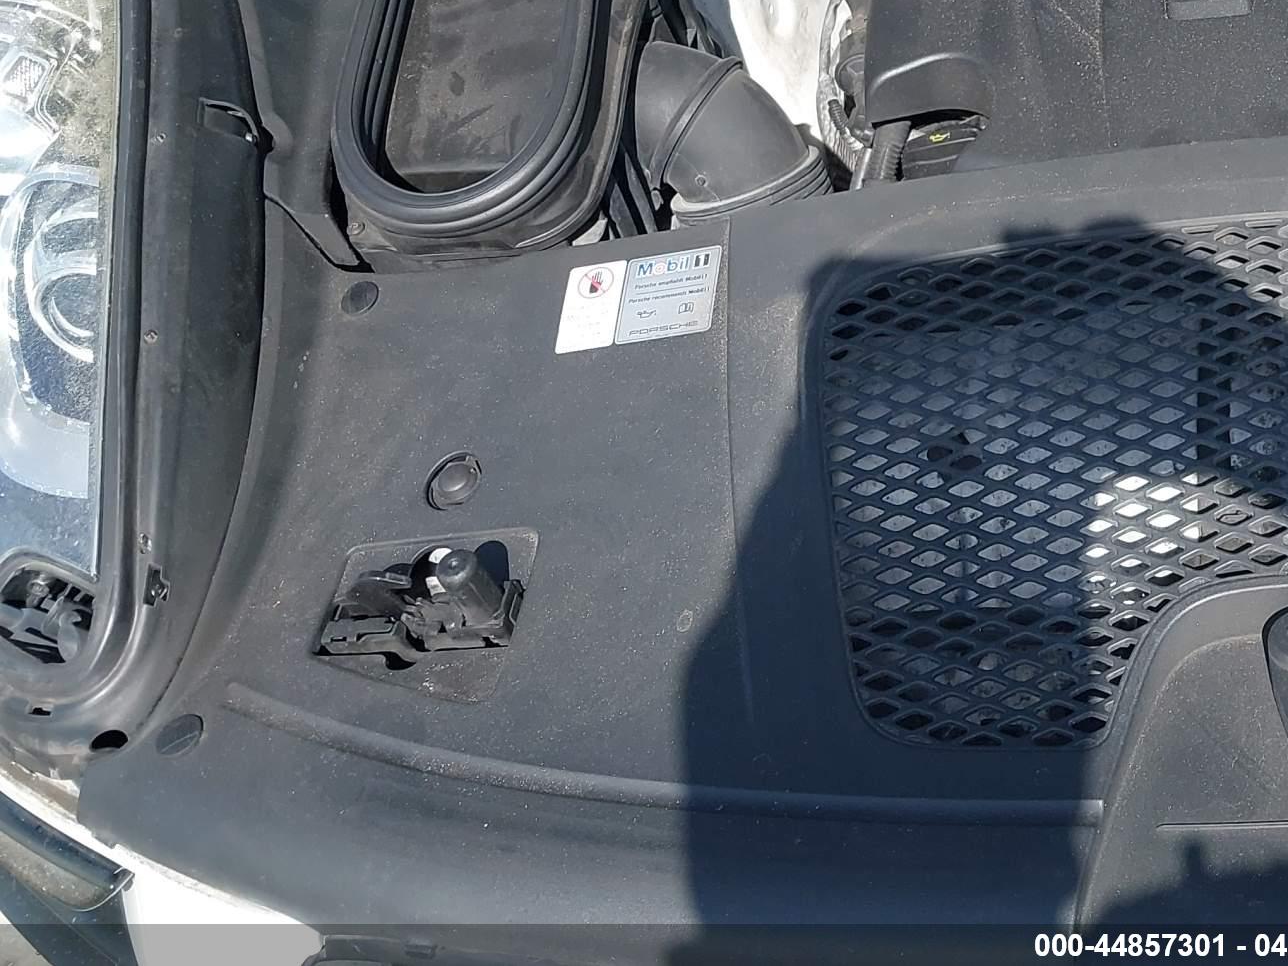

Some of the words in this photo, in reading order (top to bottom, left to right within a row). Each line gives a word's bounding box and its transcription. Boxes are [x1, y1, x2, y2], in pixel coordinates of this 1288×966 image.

[637, 257, 689, 276] Mobil
[694, 253, 710, 267] 1
[629, 321, 698, 336] PORSCHE
